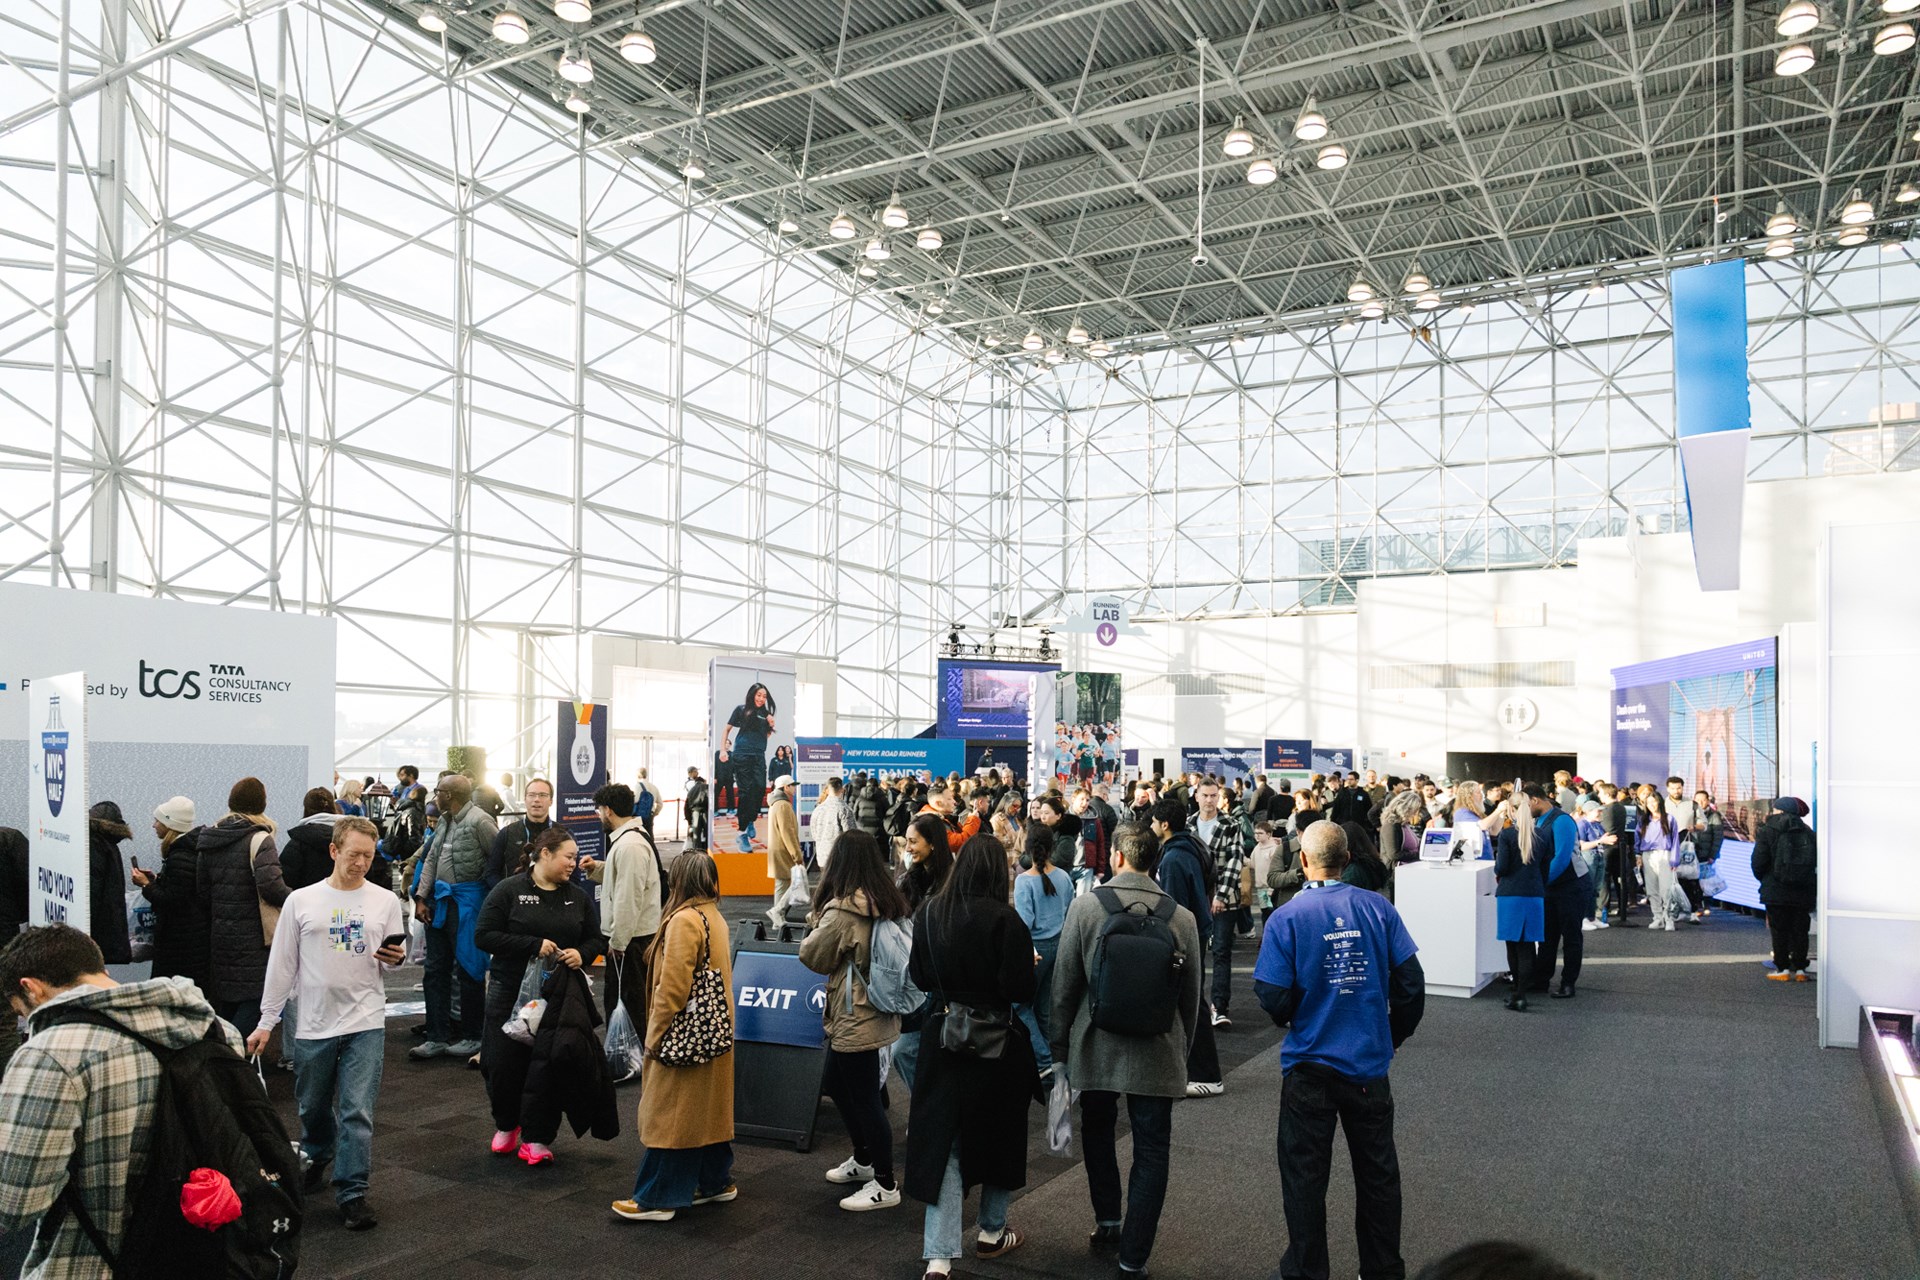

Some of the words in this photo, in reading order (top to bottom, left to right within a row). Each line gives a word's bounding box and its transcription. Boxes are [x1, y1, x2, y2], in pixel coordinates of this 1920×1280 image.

[1093, 609, 1120, 621] LAB
[1742, 650, 1766, 660] UNITED
[209, 664, 245, 676] TATA
[139, 659, 201, 700] tcs
[209, 677, 291, 692] CONSULTANCY
[110, 681, 128, 699] by
[209, 690, 262, 703] SERVICES
[47, 753, 64, 781] NYC
[48, 783, 63, 802] HALF
[38, 866, 53, 894] FIND
[54, 871, 74, 903] YOUR
[1323, 930, 1361, 941] VOLUNTEER
[738, 986, 798, 1010] EXIT
